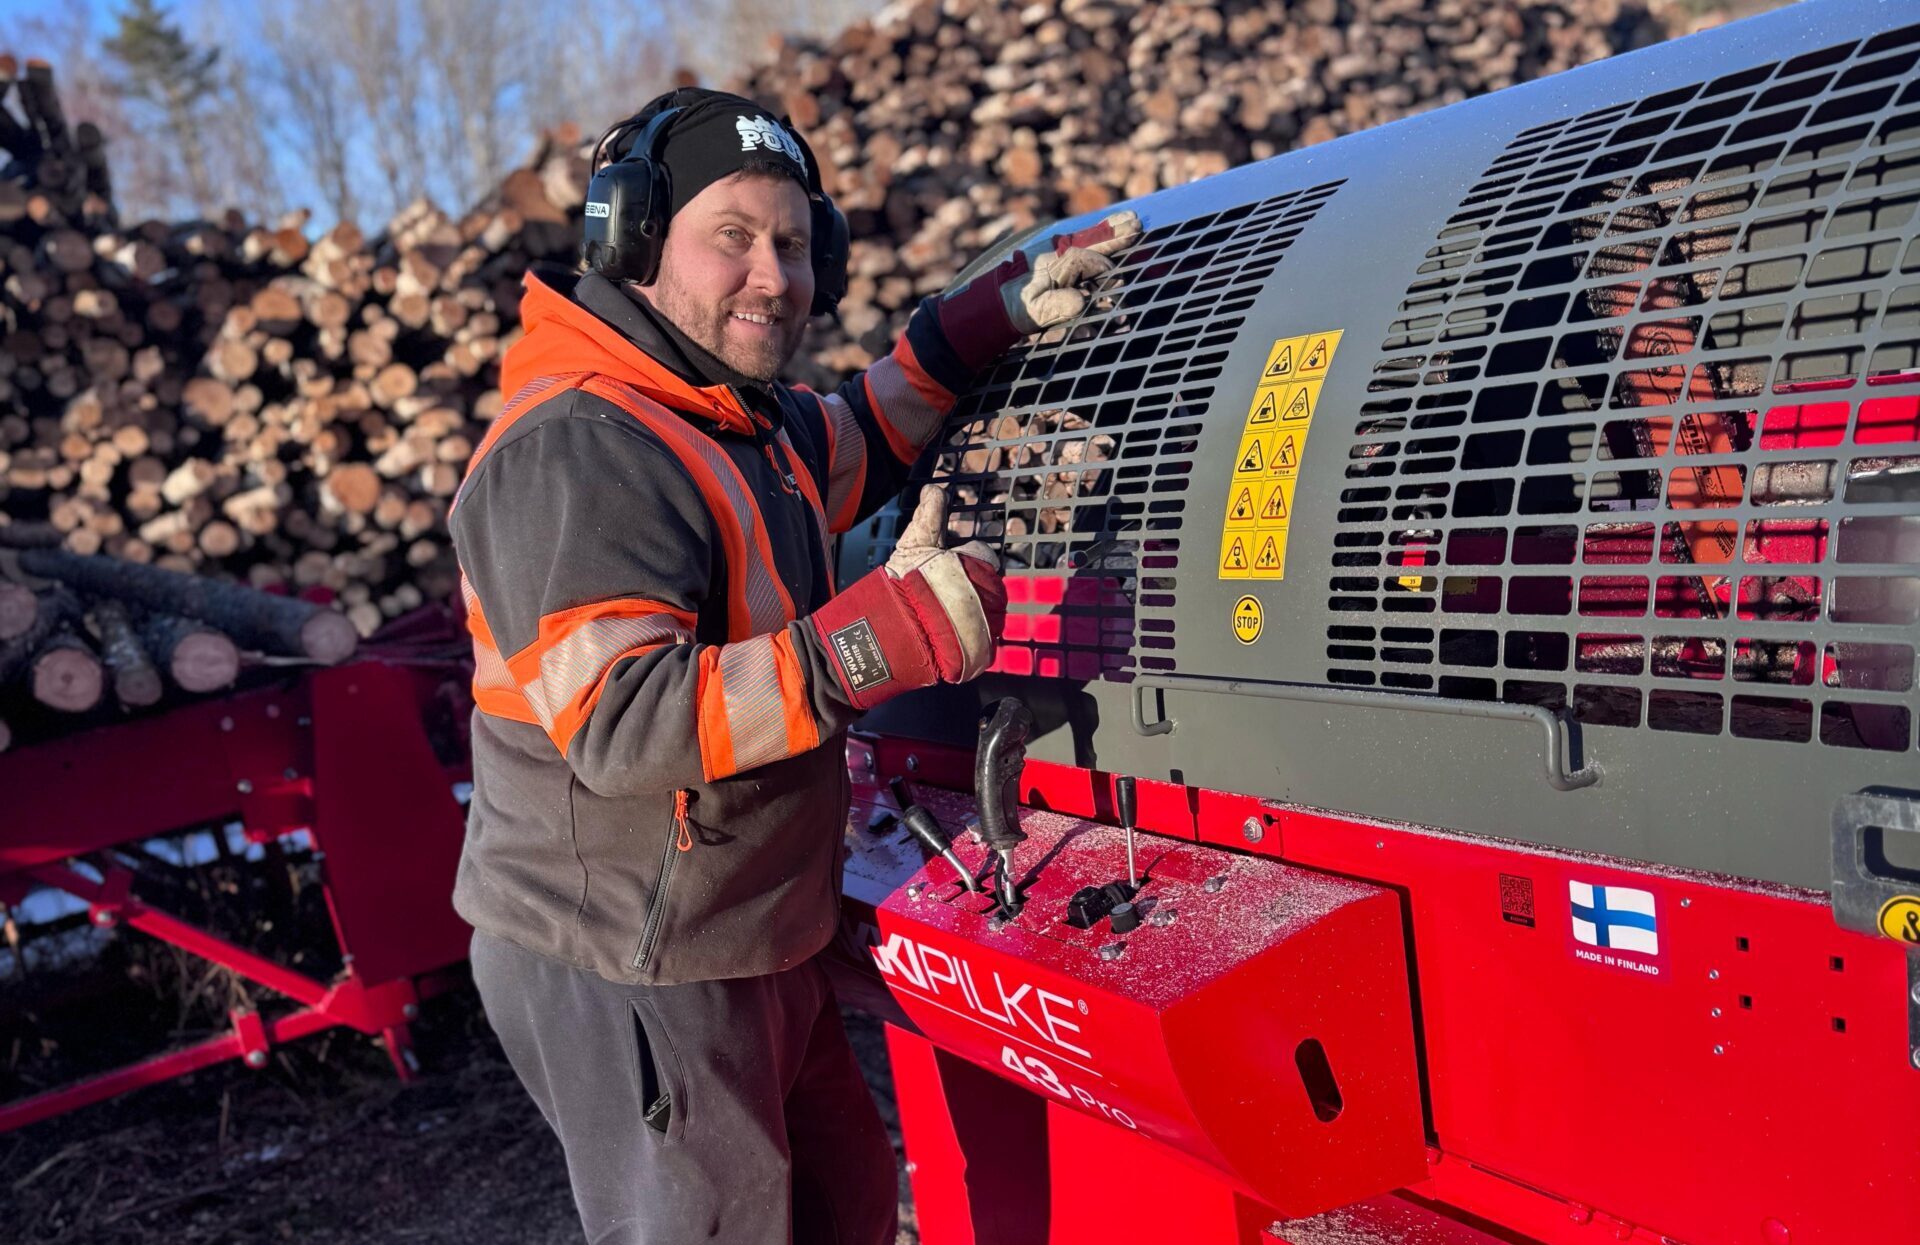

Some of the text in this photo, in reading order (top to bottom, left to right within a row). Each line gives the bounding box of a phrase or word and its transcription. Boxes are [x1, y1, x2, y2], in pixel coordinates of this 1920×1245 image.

[1237, 616, 1258, 629] STOP
[851, 643, 867, 671] WINTER
[1575, 949, 1660, 976] MADE IN FINLAND
[1002, 1045, 1072, 1099] 43
